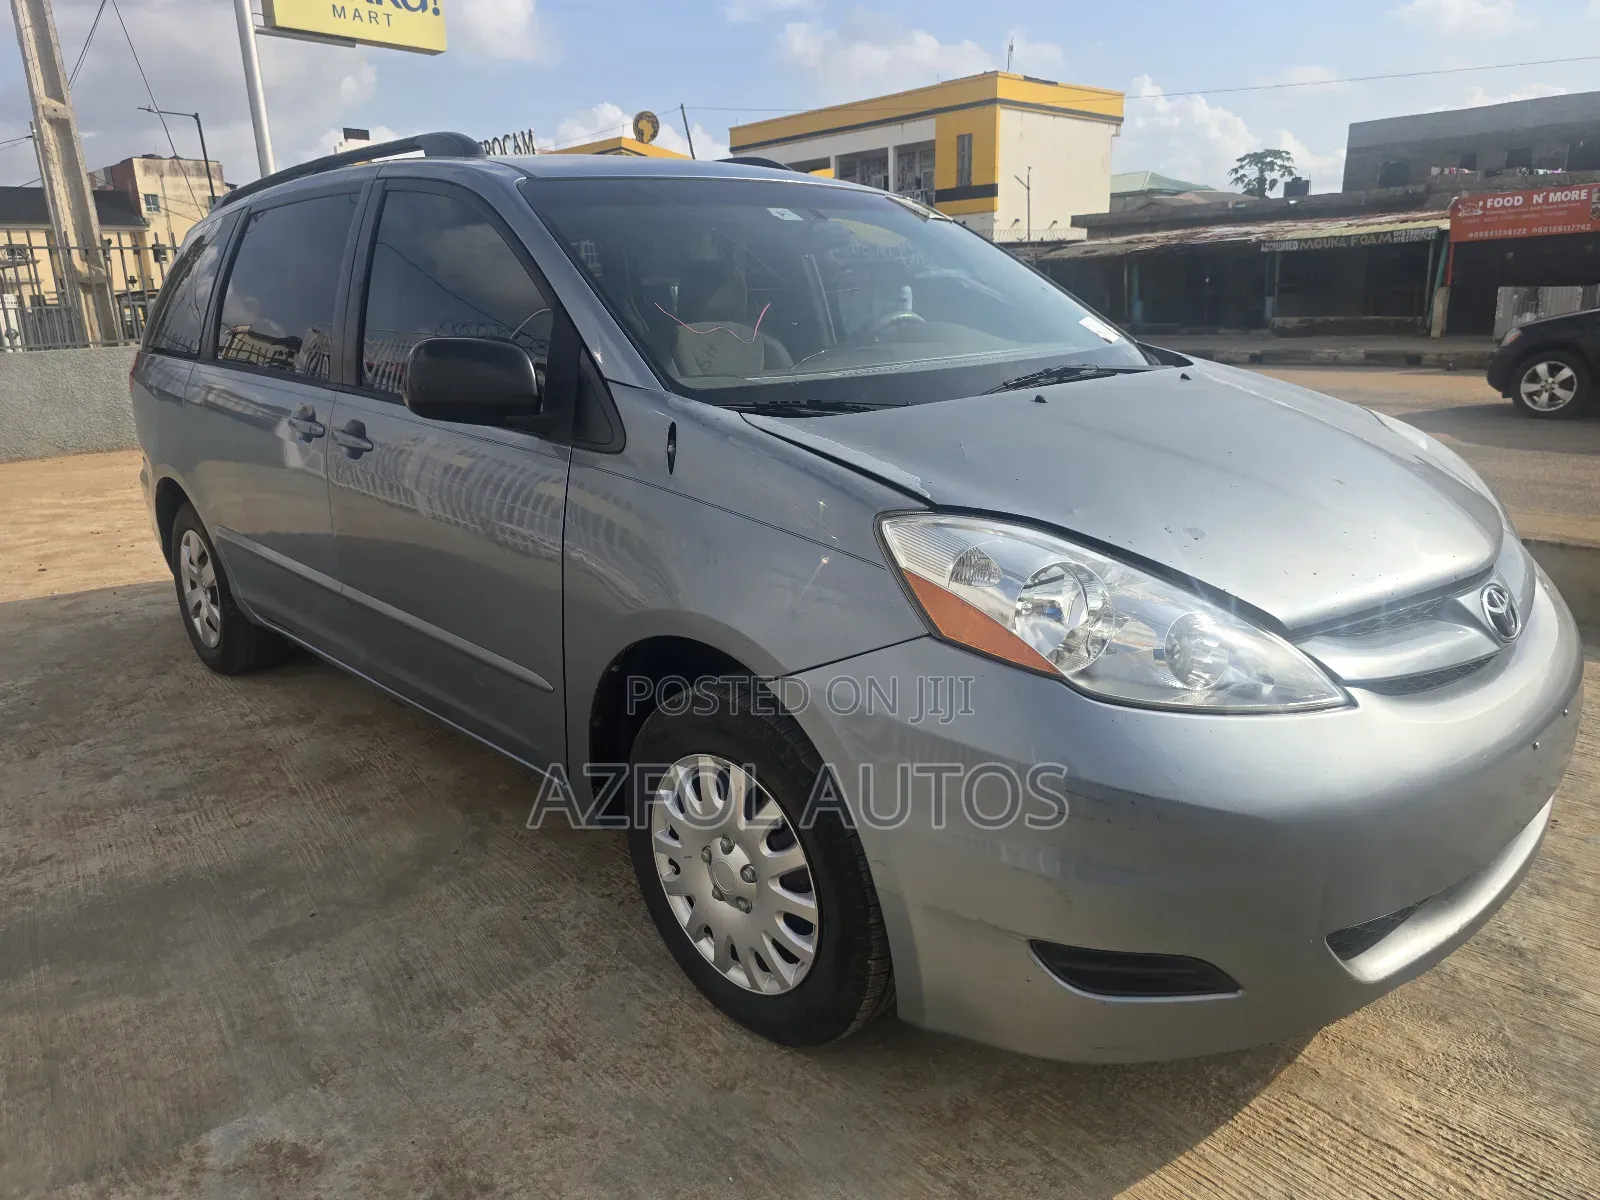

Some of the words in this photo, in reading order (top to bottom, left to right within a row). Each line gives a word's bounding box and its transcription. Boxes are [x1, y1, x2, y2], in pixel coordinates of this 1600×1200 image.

[331, 4, 393, 27] MART
[479, 128, 536, 156] ROCAM
[1486, 195, 1523, 208] FOOD
[1548, 189, 1588, 203] MORE
[1301, 236, 1347, 250] MOUKA
[1350, 231, 1393, 247] FOAM
